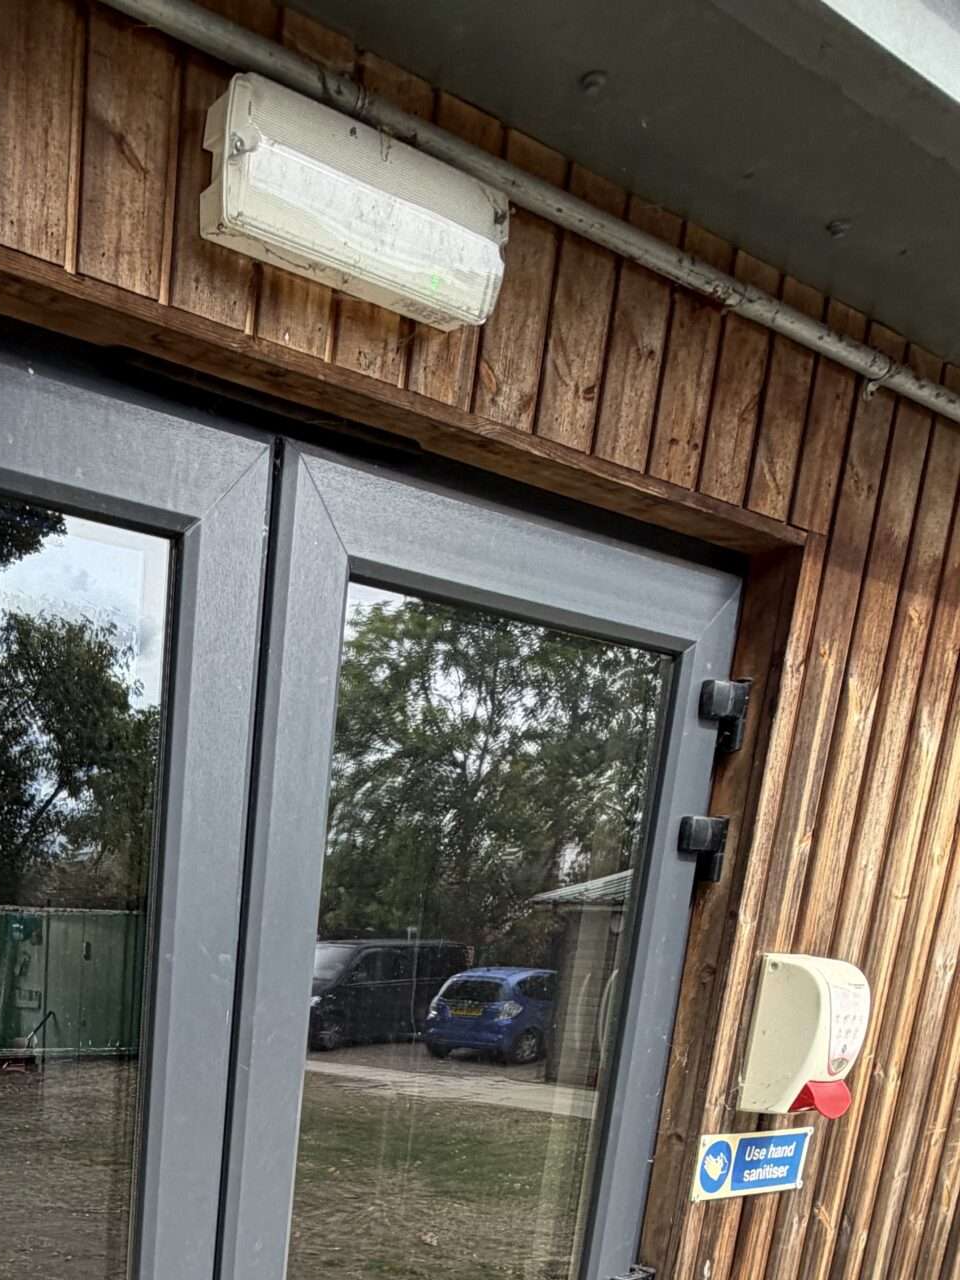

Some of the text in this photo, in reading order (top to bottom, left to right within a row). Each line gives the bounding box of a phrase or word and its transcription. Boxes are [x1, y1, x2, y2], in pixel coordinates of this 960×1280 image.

[745, 1141, 797, 1161] Use hand
[743, 1164, 790, 1182] sanitiser
